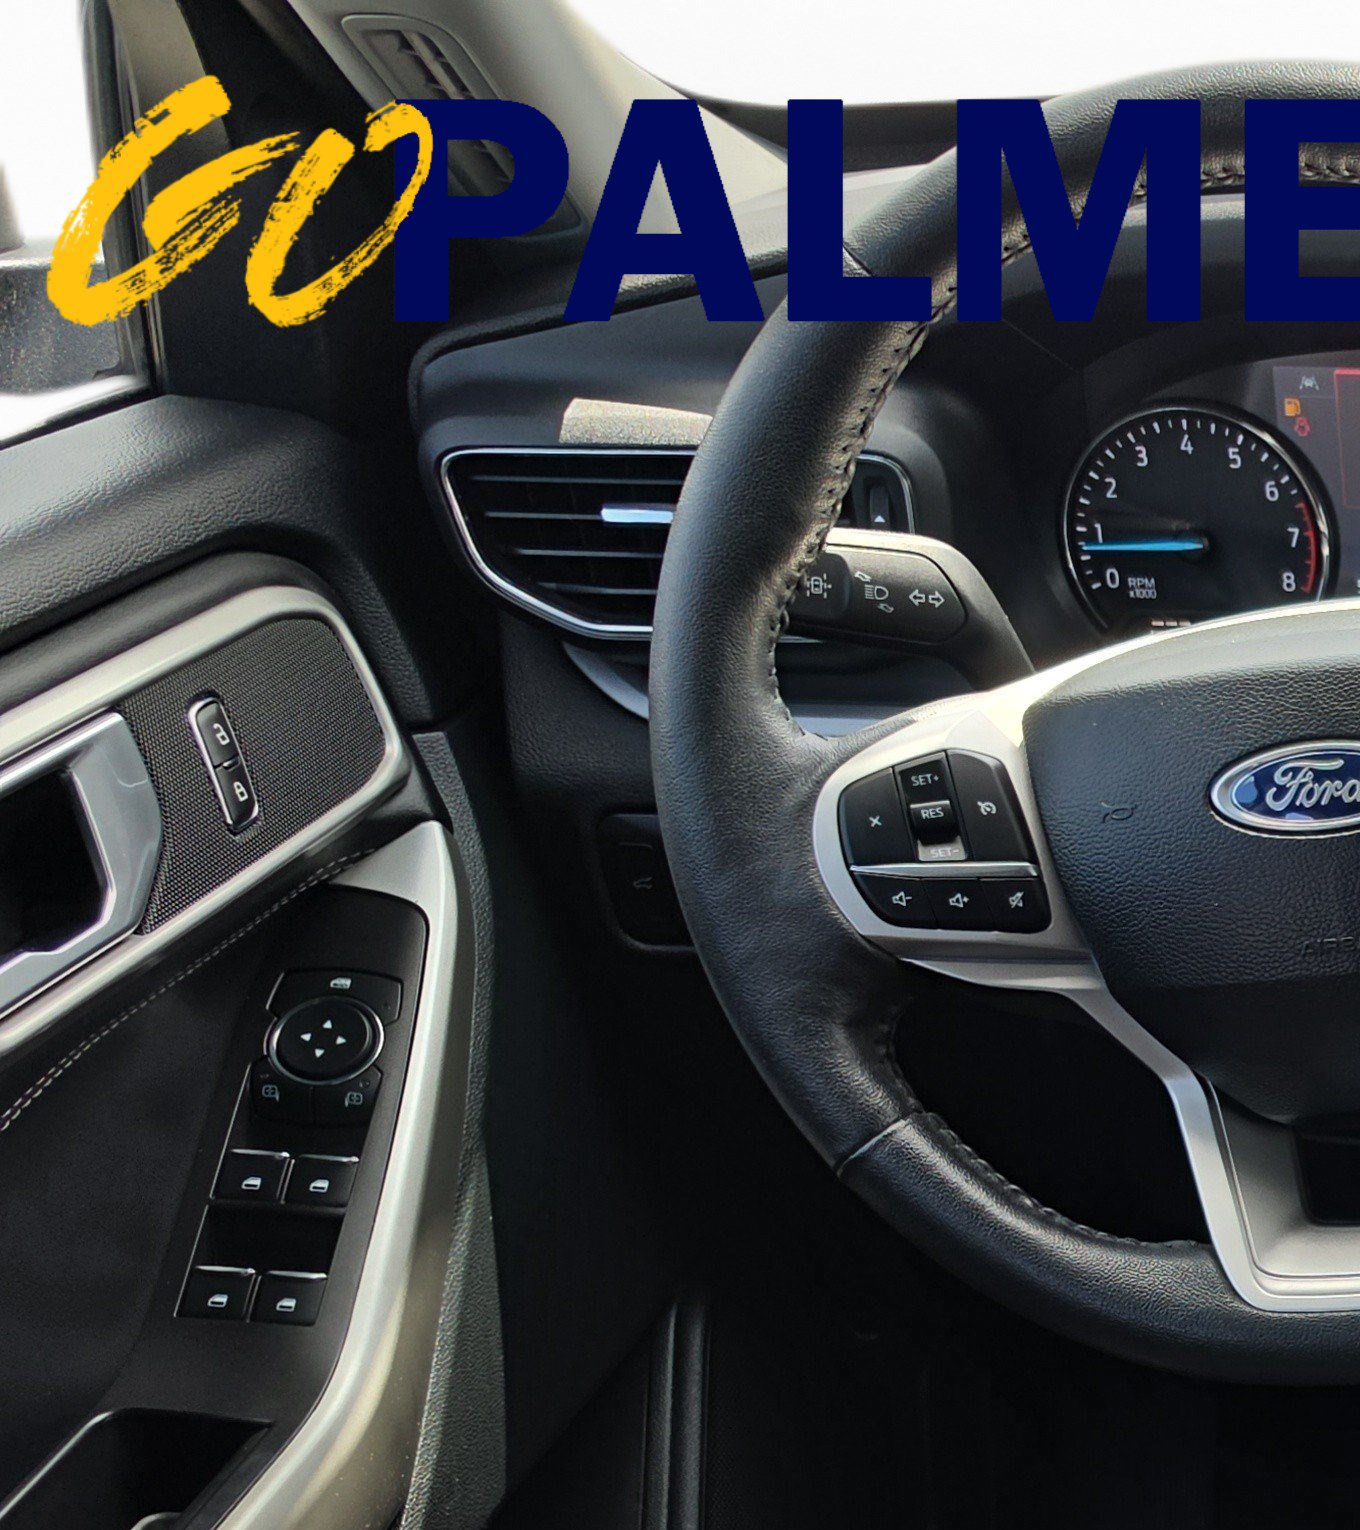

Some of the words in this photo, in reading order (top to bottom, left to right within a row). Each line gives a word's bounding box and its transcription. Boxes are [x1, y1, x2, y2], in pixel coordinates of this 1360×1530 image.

[1179, 434, 1194, 455] 4
[1134, 446, 1149, 467] 3
[1228, 448, 1242, 469] 5
[1104, 477, 1118, 498] 2
[1265, 480, 1279, 501] 6
[1094, 522, 1103, 544] 1
[1287, 527, 1300, 548] 7
[1106, 568, 1119, 589] 0
[1127, 577, 1155, 590] RPM
[1281, 571, 1296, 592] 8
[920, 807, 944, 820] RES
